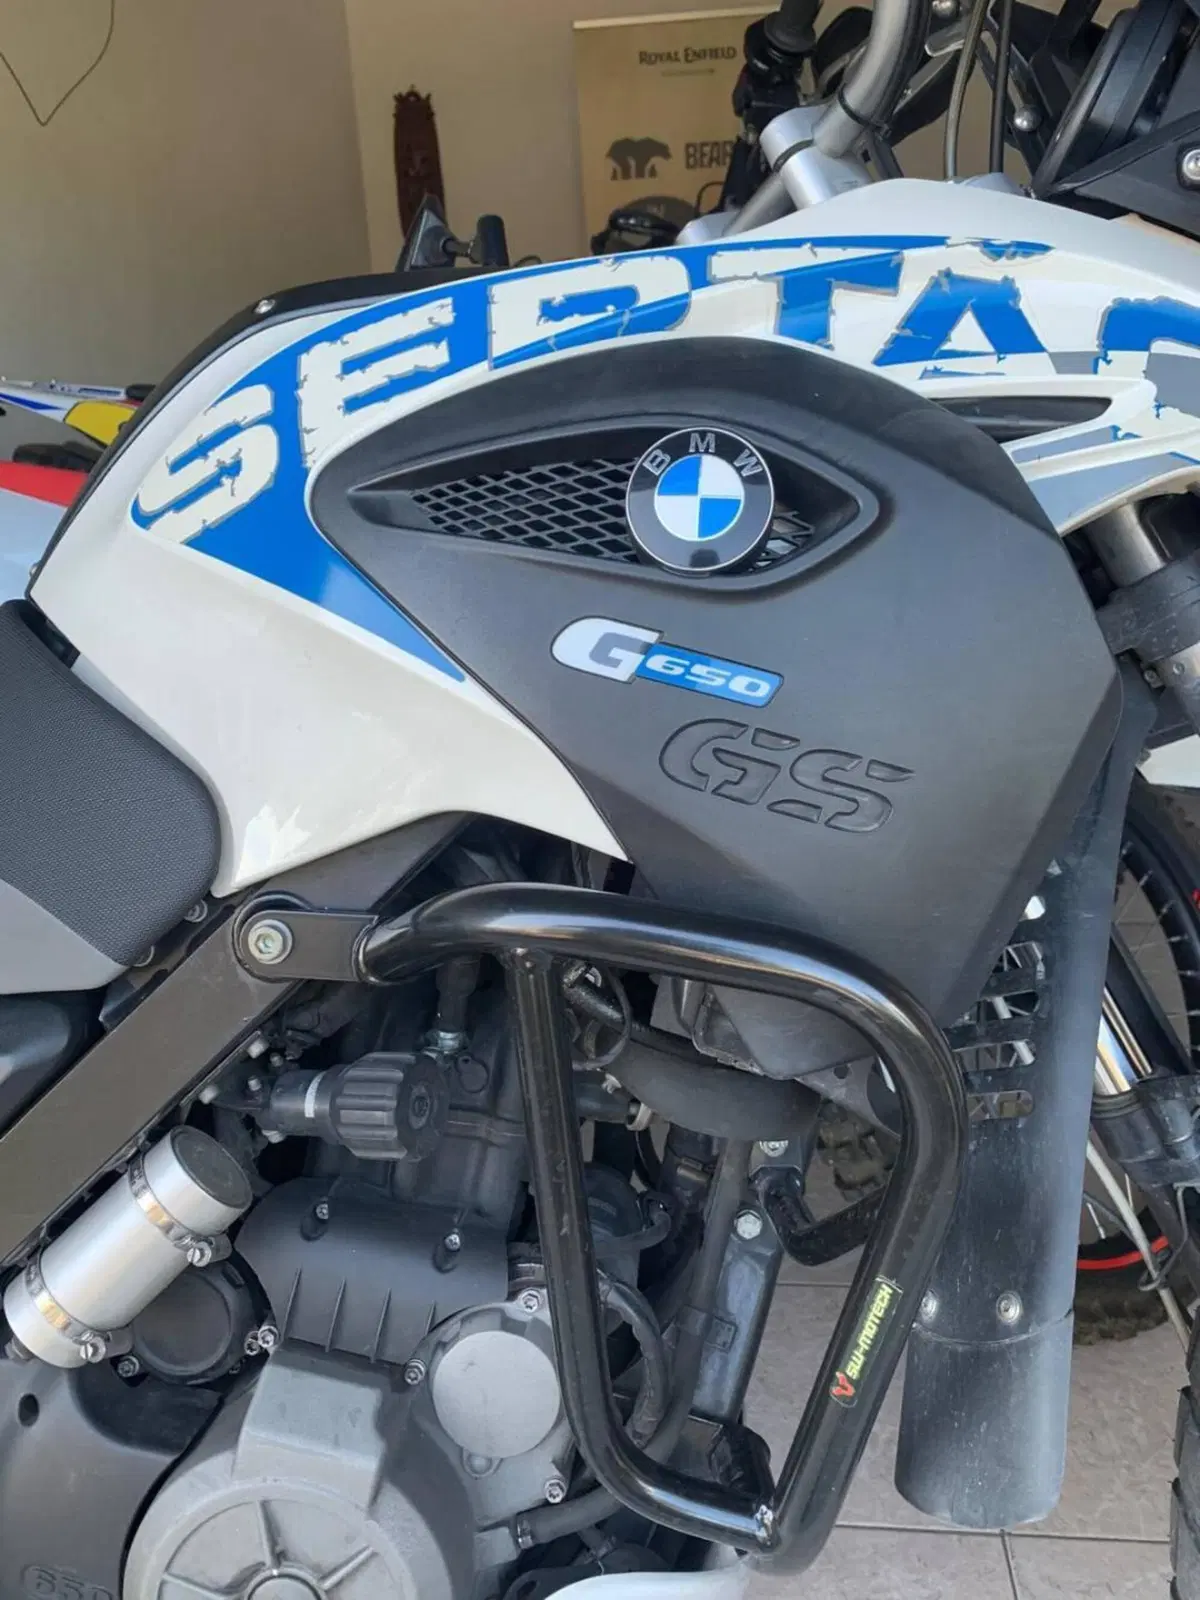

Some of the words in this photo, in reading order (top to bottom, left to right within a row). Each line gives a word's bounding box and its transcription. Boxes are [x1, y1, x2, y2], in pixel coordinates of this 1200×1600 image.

[638, 50, 681, 66] ROYAL
[683, 46, 738, 64] ENFIELD
[642, 432, 763, 477] BMW
[659, 717, 915, 834] GS
[846, 1283, 894, 1380] SW-MOTECH
